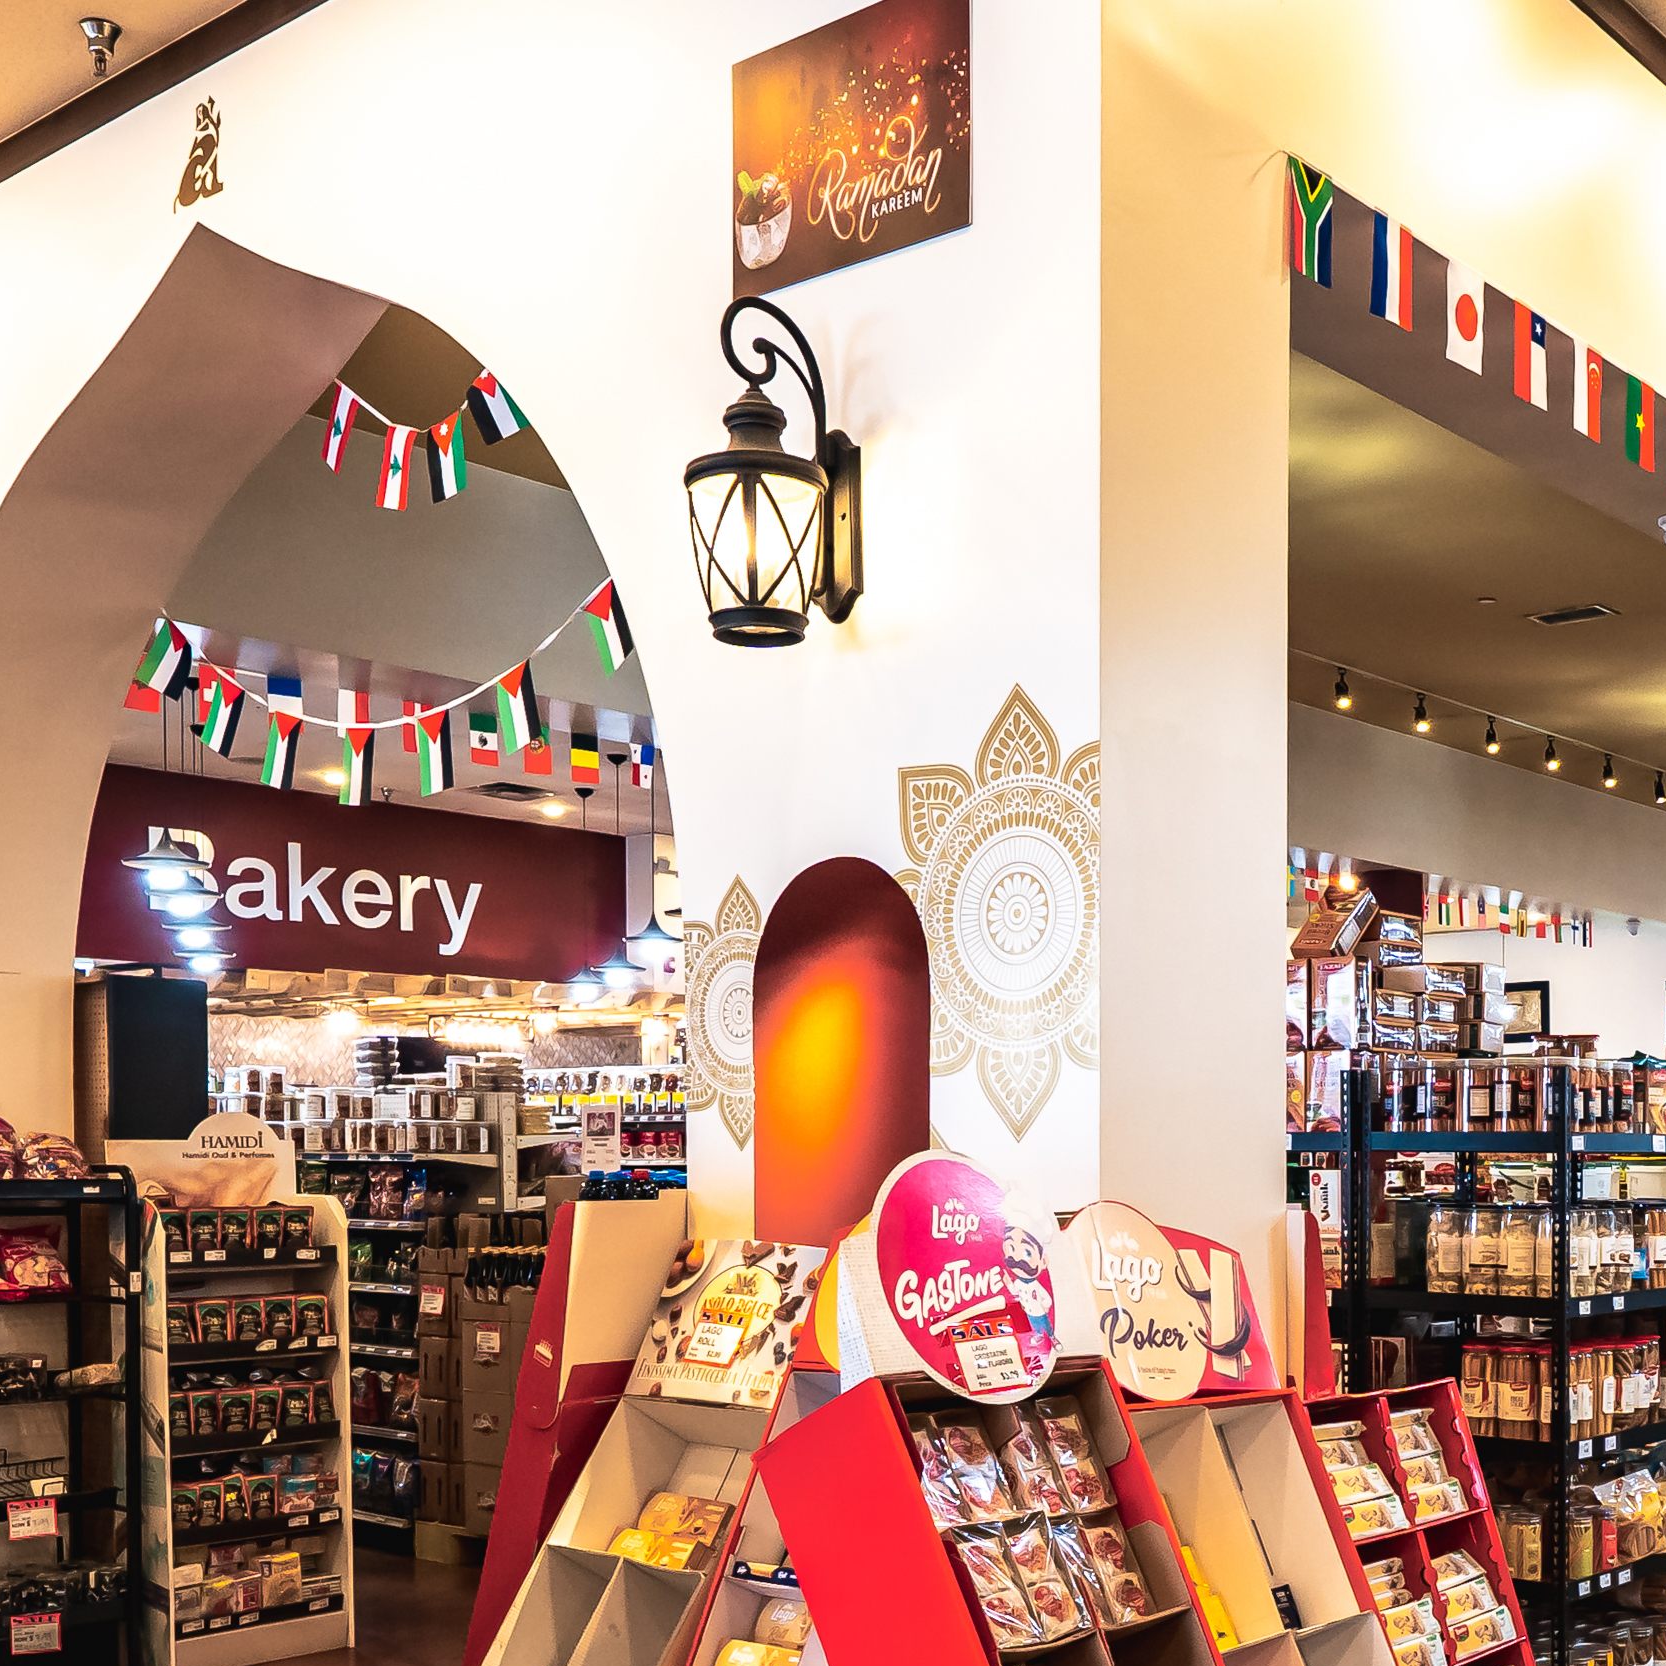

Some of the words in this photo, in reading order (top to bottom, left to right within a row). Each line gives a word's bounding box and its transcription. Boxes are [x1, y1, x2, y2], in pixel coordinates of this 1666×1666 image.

[807, 116, 944, 240] Ramadan
[870, 187, 924, 220] KAREEM
[147, 826, 482, 956] Bakery
[931, 1204, 980, 1246] Lago
[894, 1258, 1005, 1328] GASTONE
[1092, 1243, 1162, 1302] Lago
[697, 1338, 715, 1346] ROLL
[702, 1326, 723, 1335] LAGO
[1101, 1308, 1188, 1361] Poker
